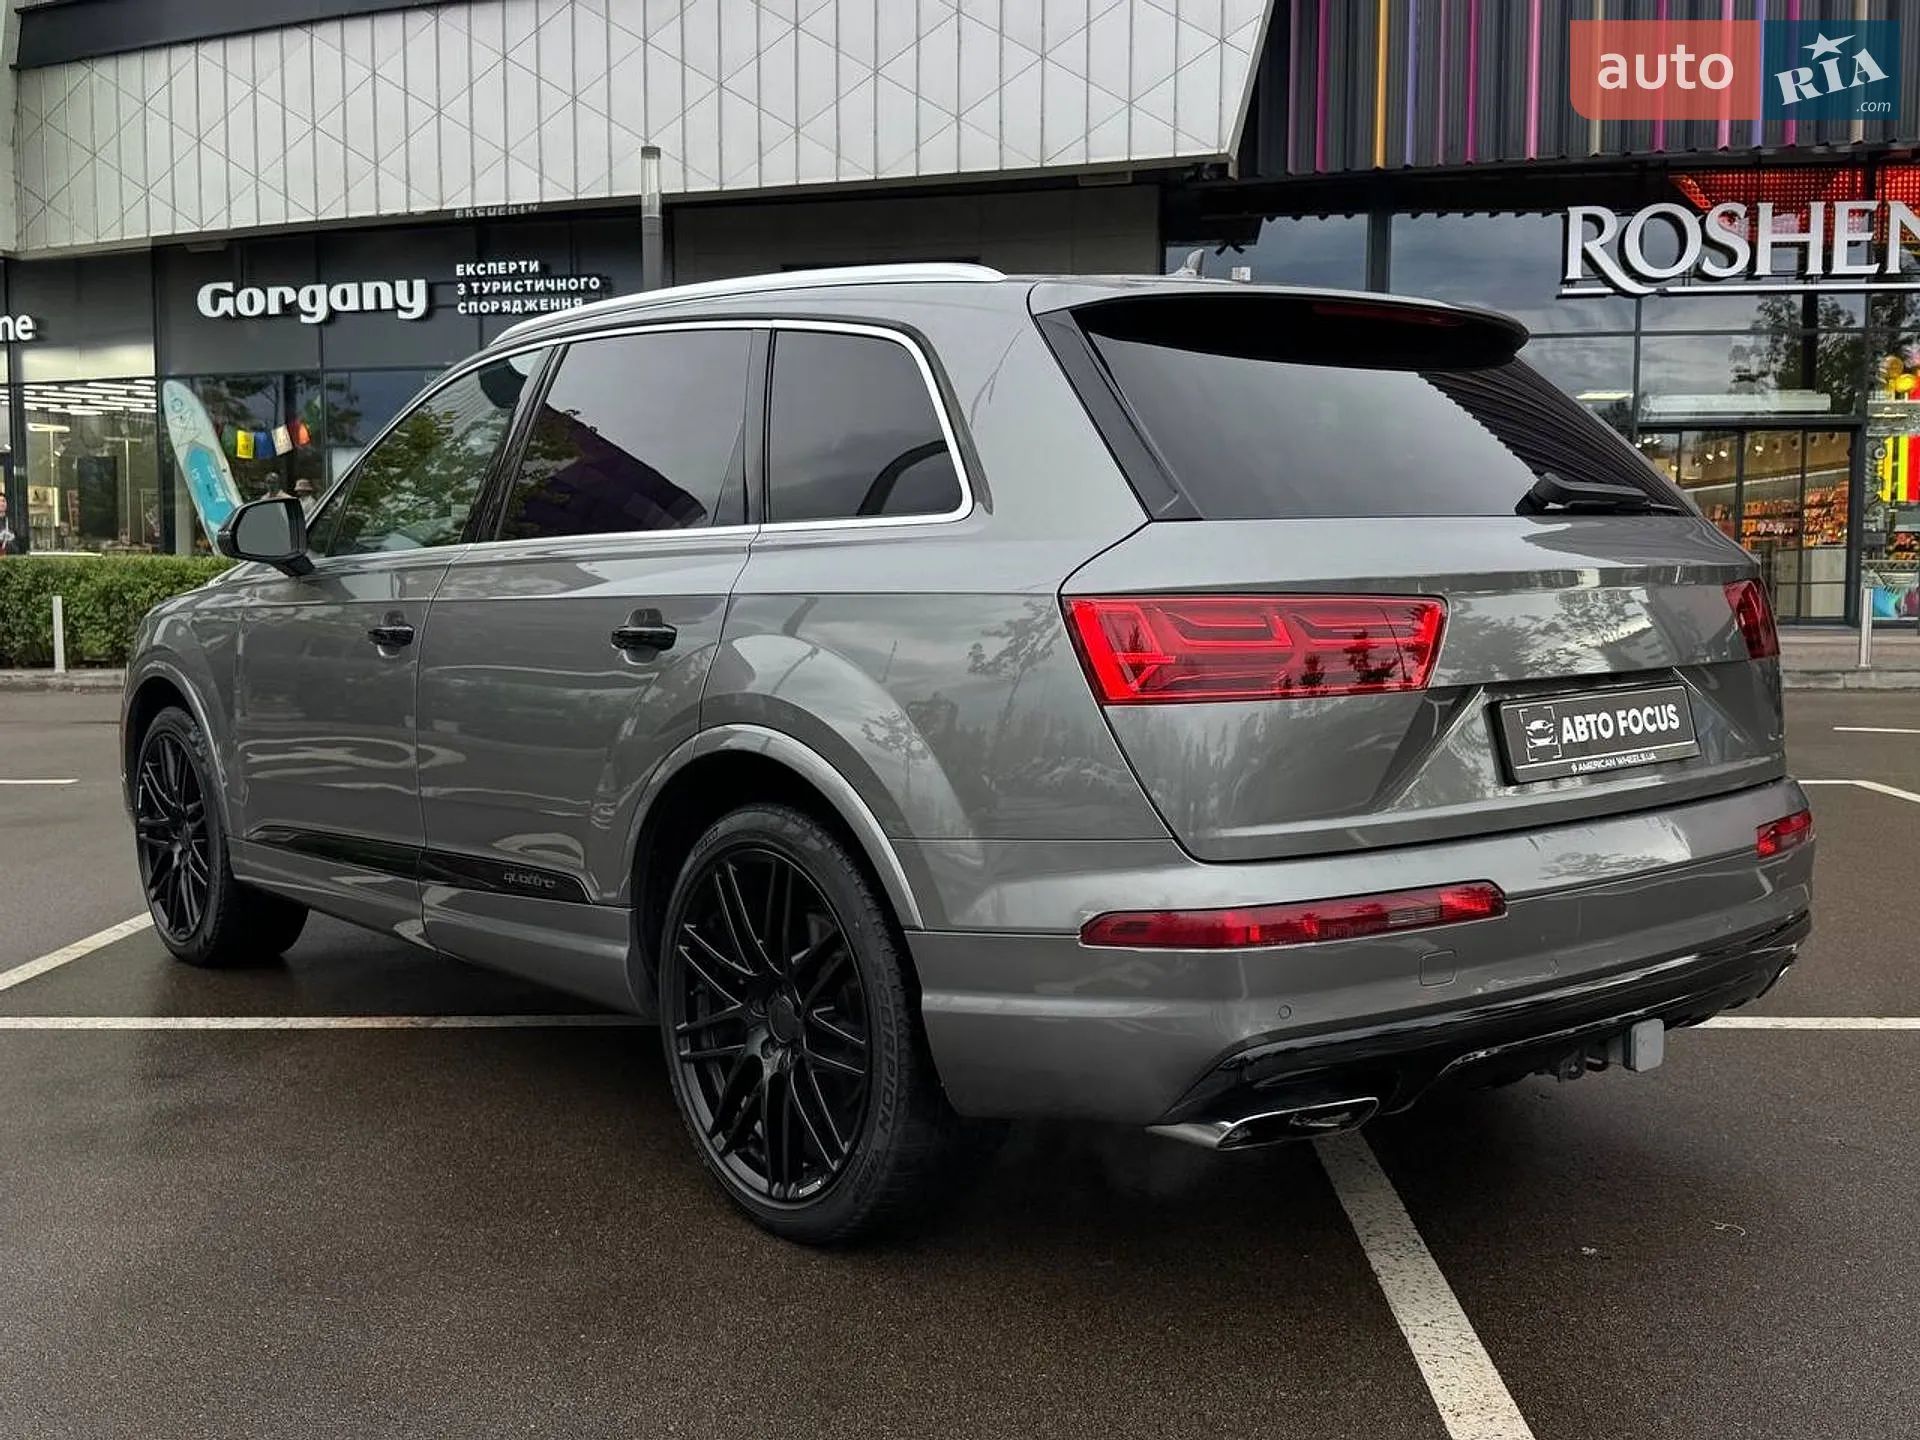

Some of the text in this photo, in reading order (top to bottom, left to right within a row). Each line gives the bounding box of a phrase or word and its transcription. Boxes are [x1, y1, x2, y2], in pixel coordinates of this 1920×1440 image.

[455, 260, 540, 276] ЕКСПЕРТИ
[471, 277, 600, 295] ТУРИСТИЧНОГО
[197, 279, 427, 324] Gorgany
[457, 297, 584, 314] СПОРЯДЖЕННЯ
[1616, 703, 1681, 737] FOCUS
